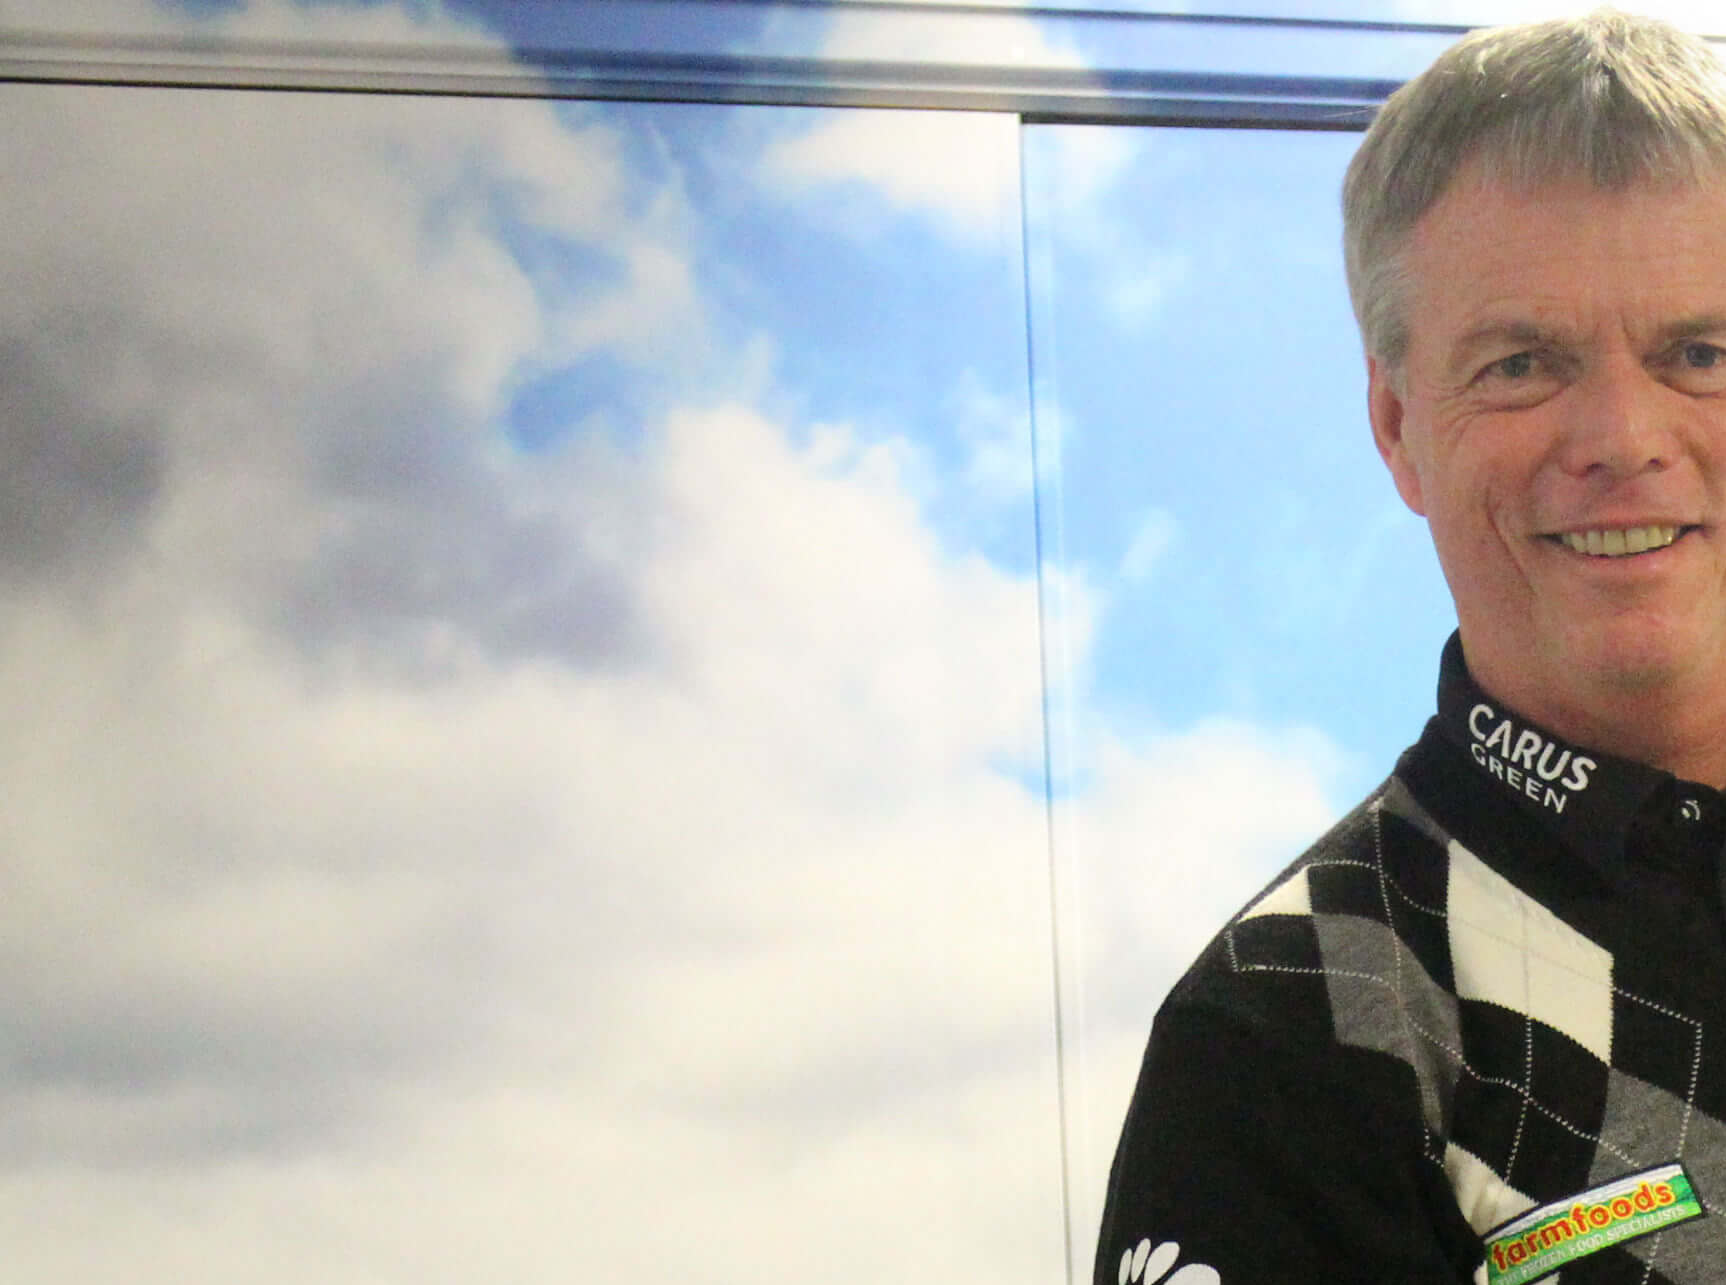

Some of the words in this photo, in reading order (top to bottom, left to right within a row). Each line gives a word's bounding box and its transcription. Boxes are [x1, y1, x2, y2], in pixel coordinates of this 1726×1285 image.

[1469, 703, 1597, 791] CARUS
[1471, 743, 1567, 814] GREEN
[1491, 1181, 1677, 1273] farmfoods
